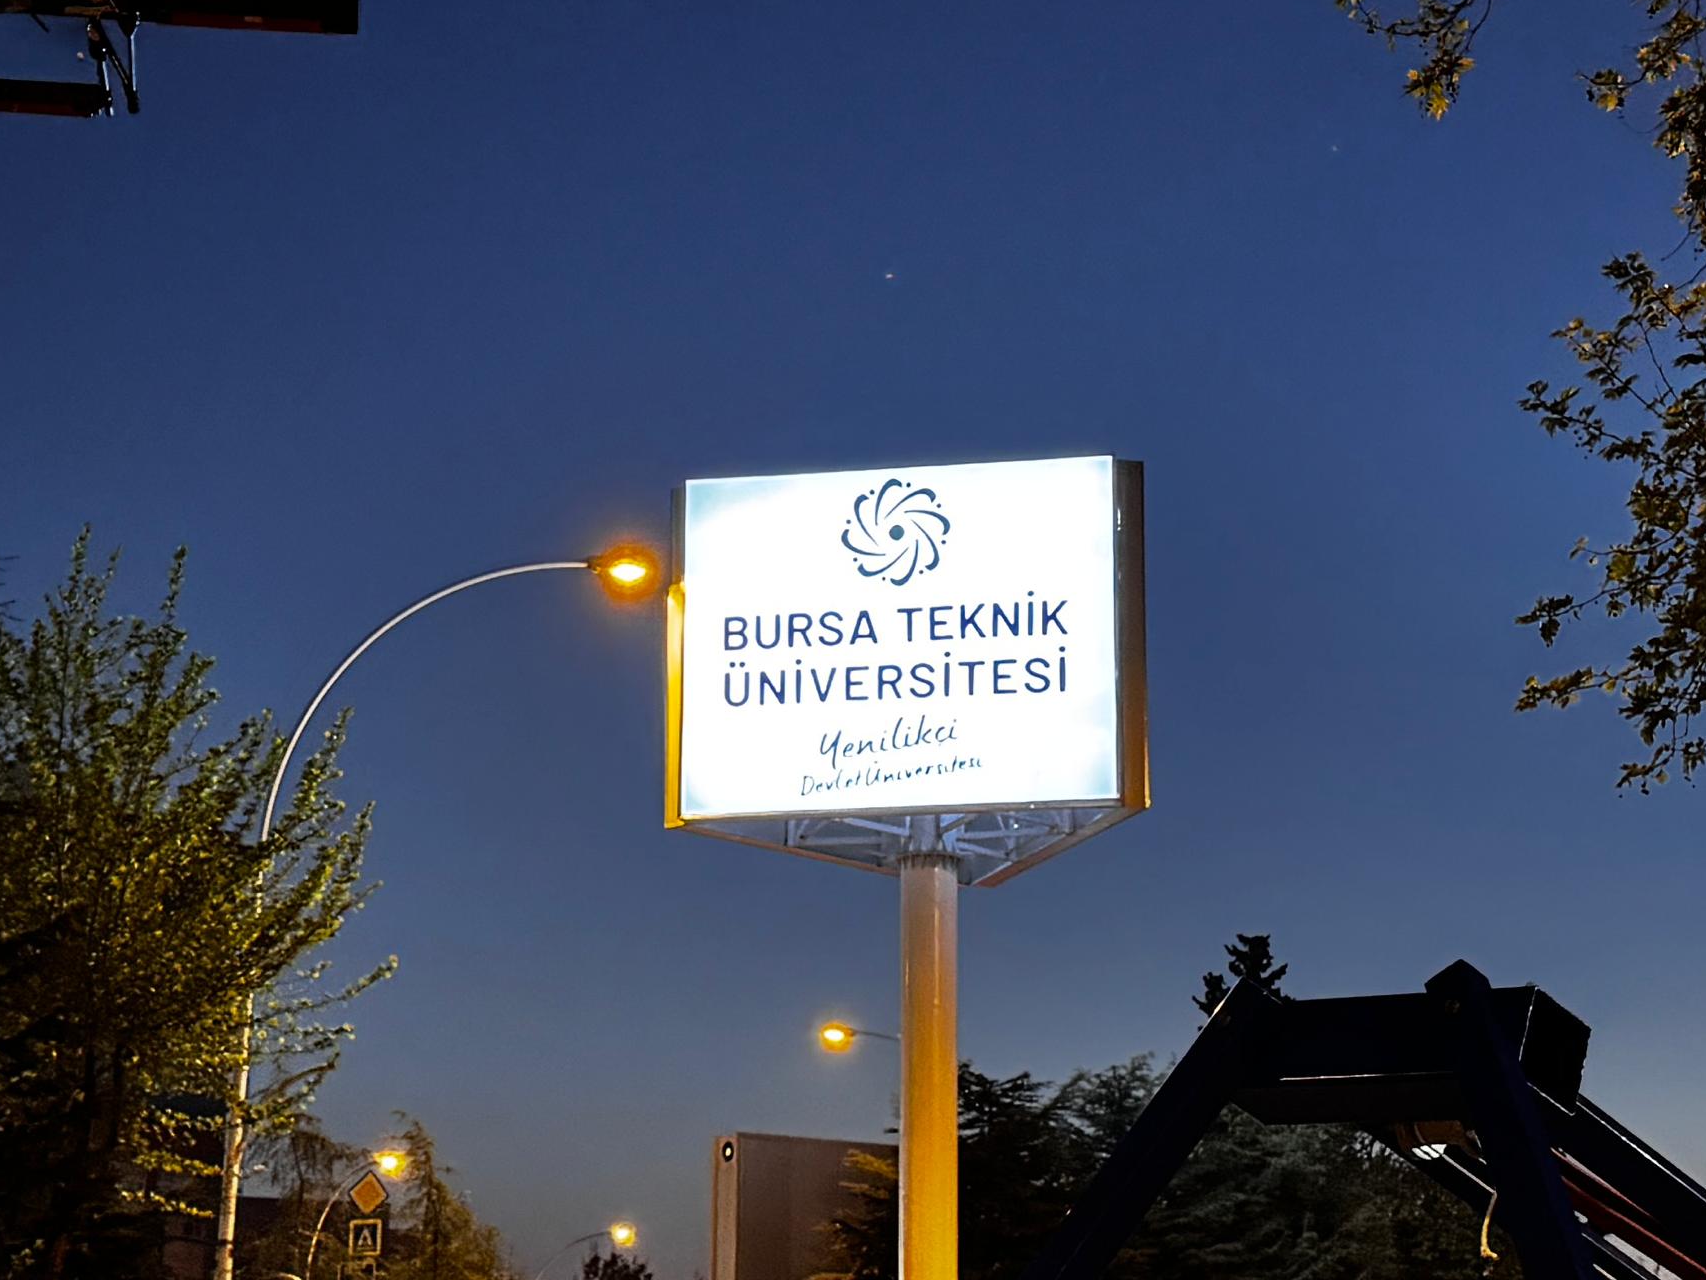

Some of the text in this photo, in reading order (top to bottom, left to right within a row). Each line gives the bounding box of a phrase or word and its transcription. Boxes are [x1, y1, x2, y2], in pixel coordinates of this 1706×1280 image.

[722, 589, 1070, 652] BURSA TEKNİK
[723, 645, 1068, 708] ÜNİVERSİTESİ
[819, 714, 959, 770] Yenilikçi
